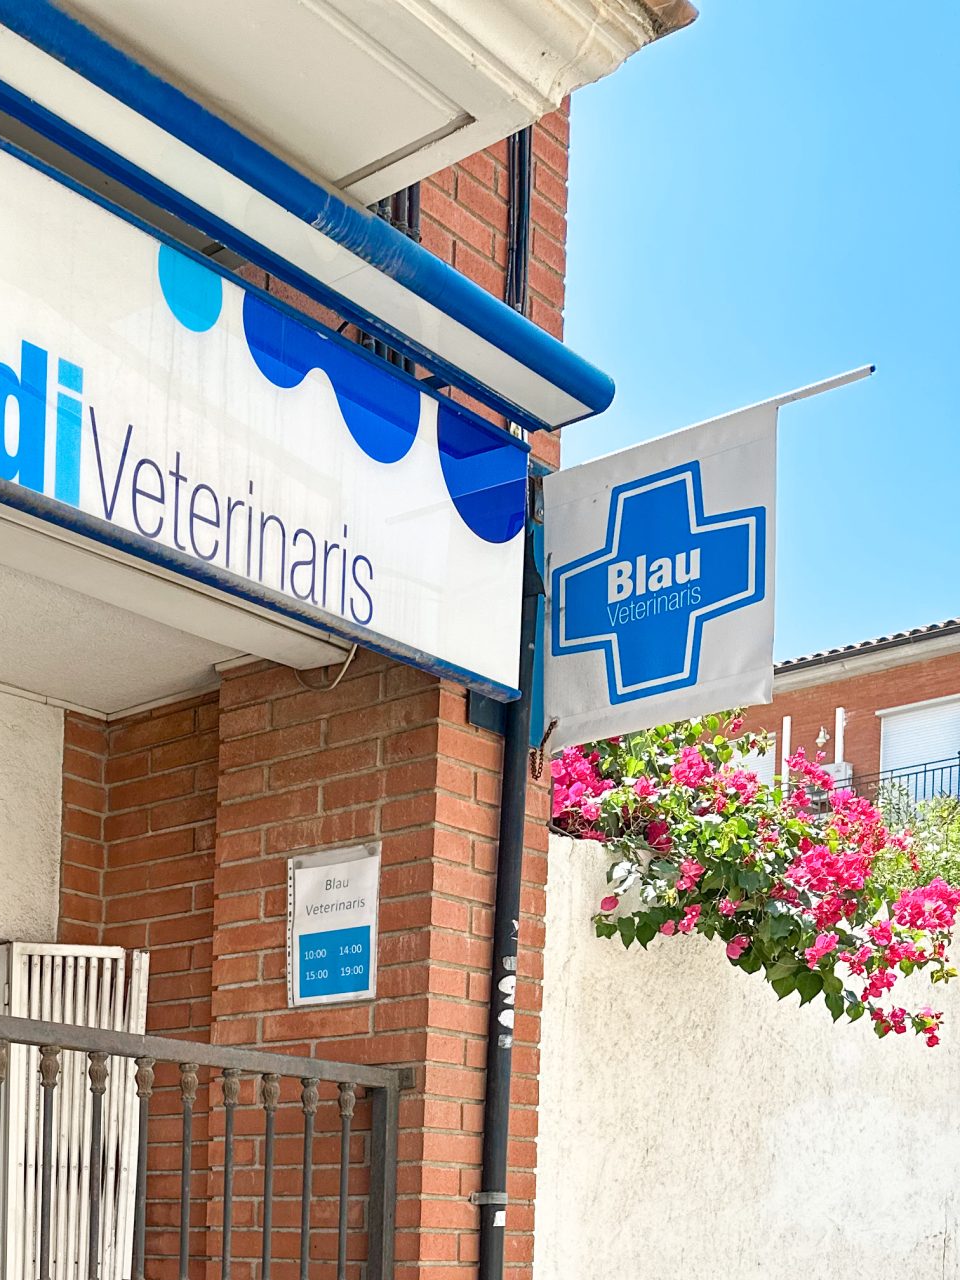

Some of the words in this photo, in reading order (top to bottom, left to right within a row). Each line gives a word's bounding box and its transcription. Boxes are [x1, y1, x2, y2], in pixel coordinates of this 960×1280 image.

[89, 405, 375, 626] Veterinaris
[607, 547, 701, 605] Blau
[606, 583, 702, 627] Veterinaris
[324, 878, 349, 891] Blau
[305, 897, 366, 916] Veterinaris
[304, 949, 327, 960] 10:00
[339, 944, 362, 956] 14:00
[305, 969, 328, 981] 15:00
[340, 965, 364, 977] 19:00
